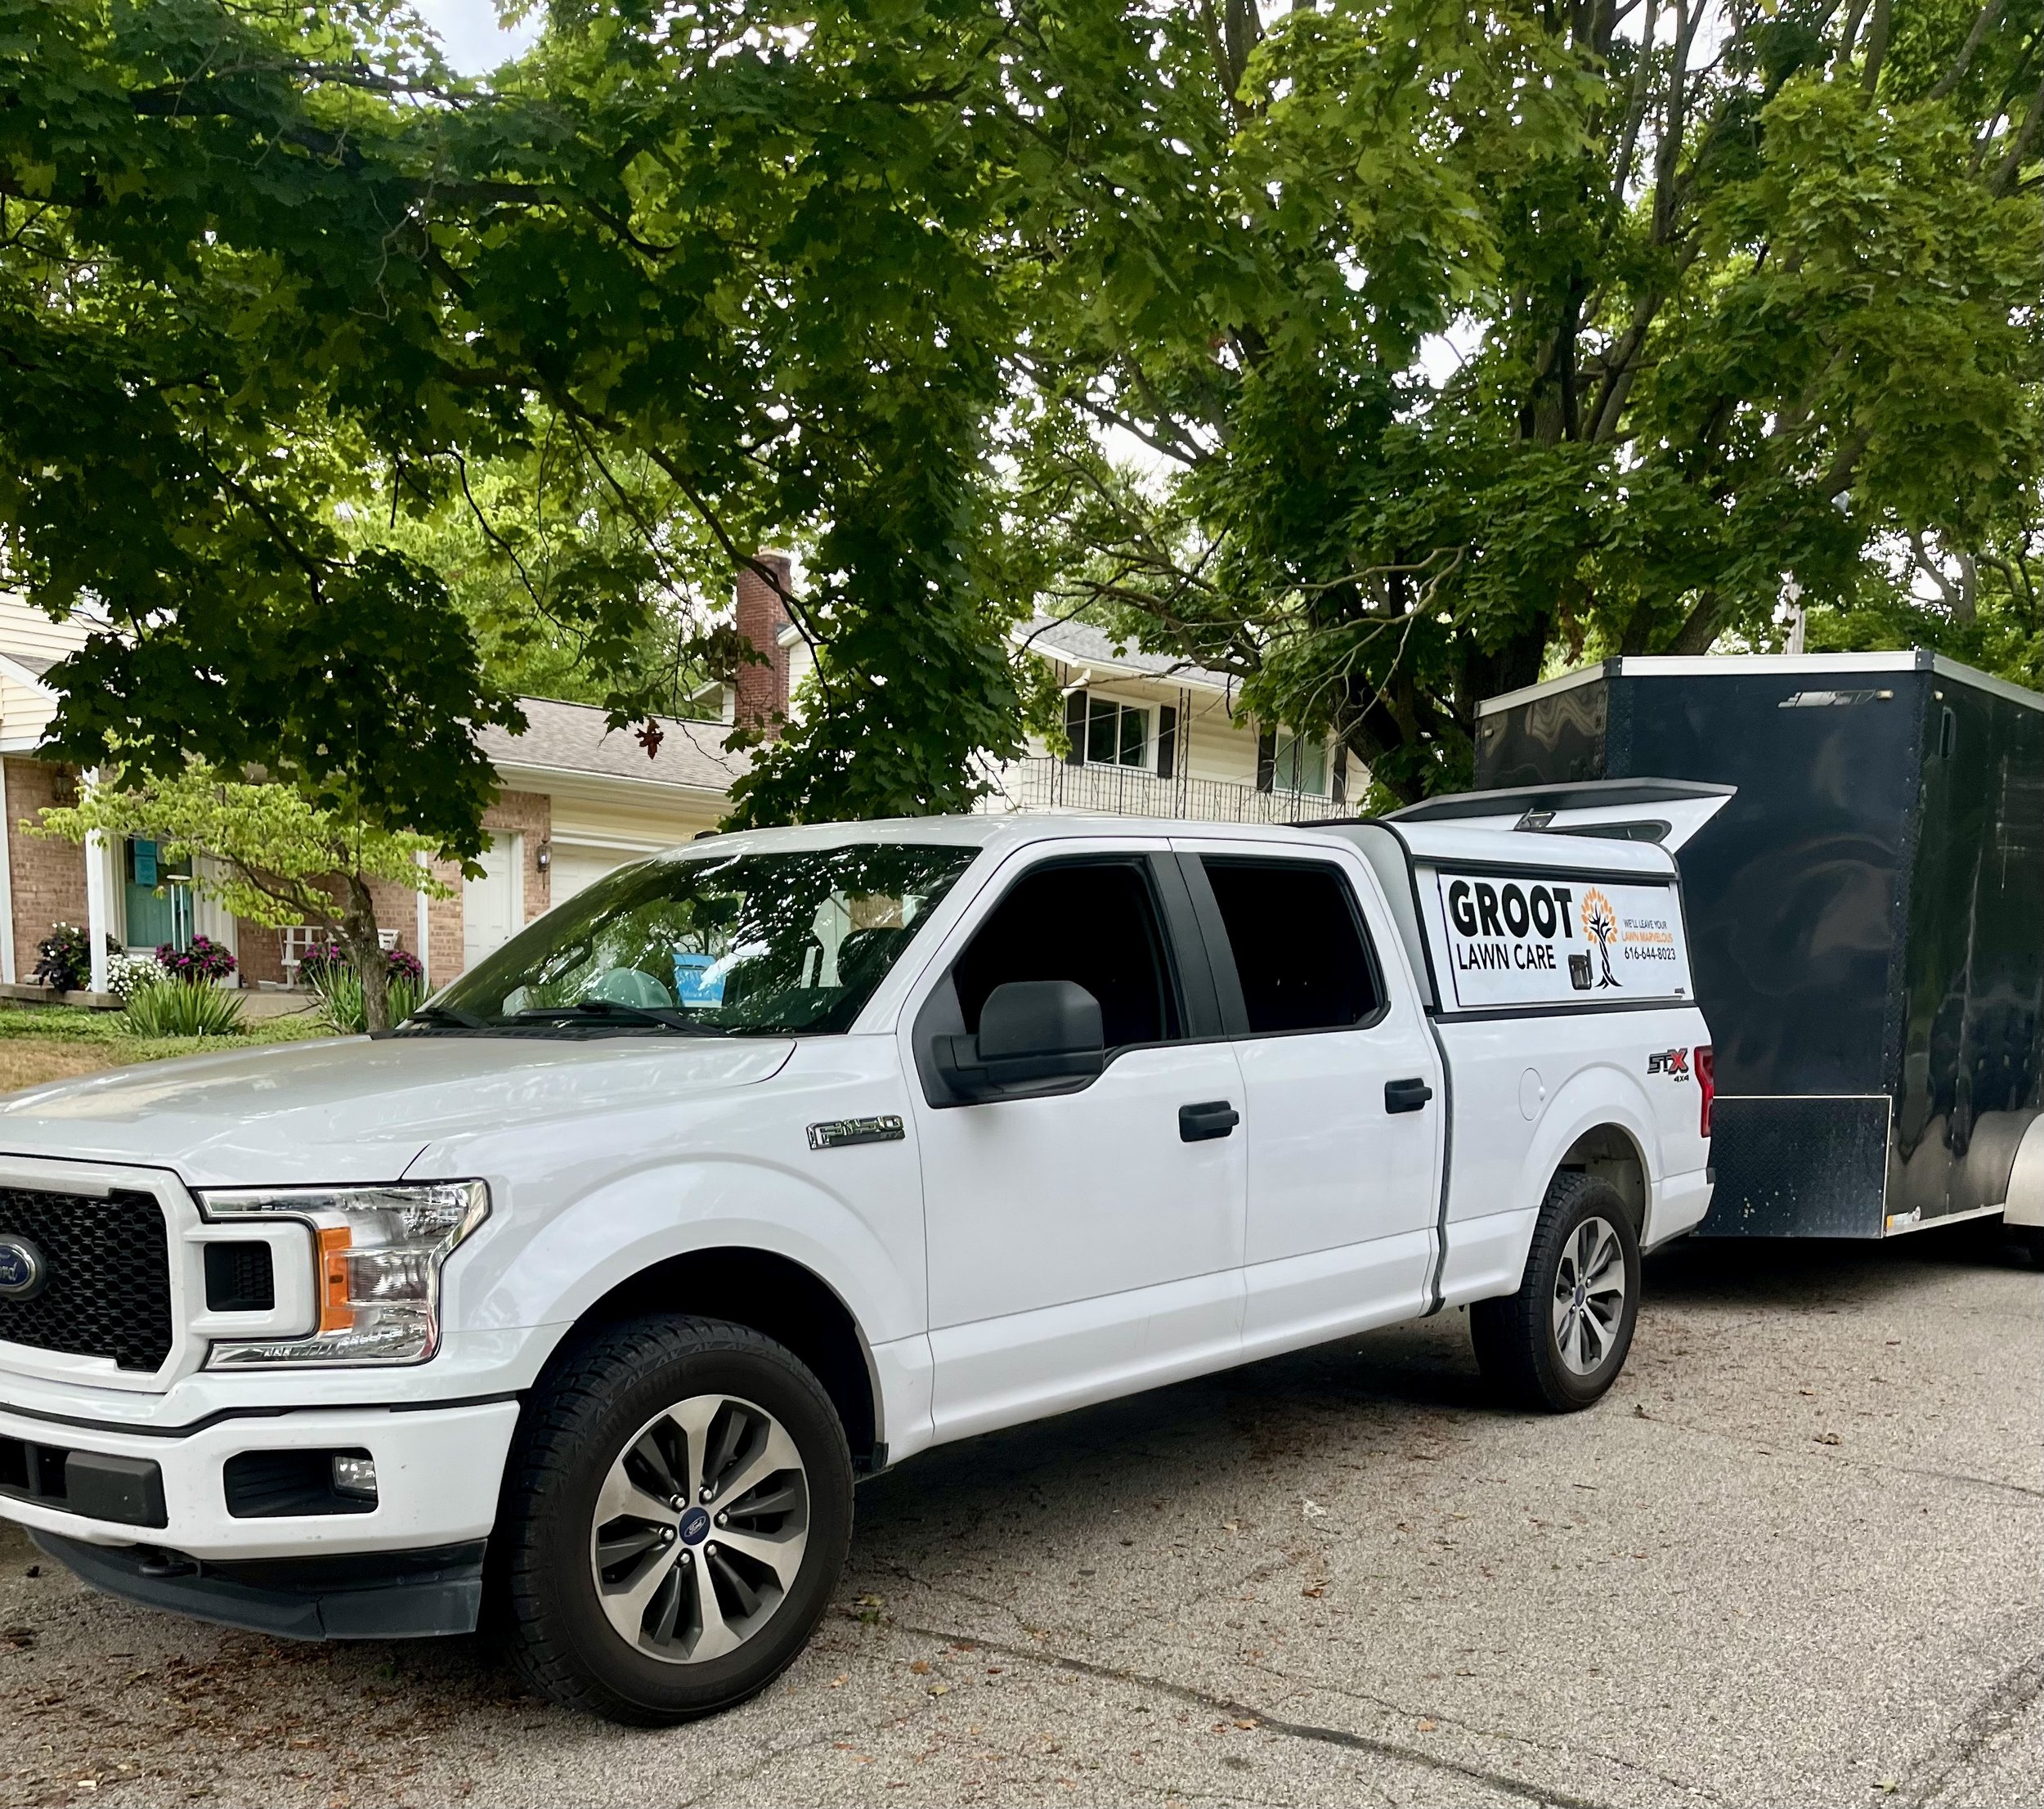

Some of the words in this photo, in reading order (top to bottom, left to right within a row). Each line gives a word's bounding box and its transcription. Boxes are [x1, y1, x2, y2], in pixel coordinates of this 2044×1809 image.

[1449, 880, 1572, 939] GROOT
[1639, 919, 1654, 929] LEAVE
[1654, 921, 1667, 929] YOUR
[1621, 931, 1638, 942] LAWN
[1639, 932, 1673, 943] MARVELOUS
[1457, 944, 1510, 970] LAWN
[1514, 944, 1557, 970] CARE
[1625, 946, 1676, 960] 616-644-8023
[1647, 1048, 1688, 1075] STX
